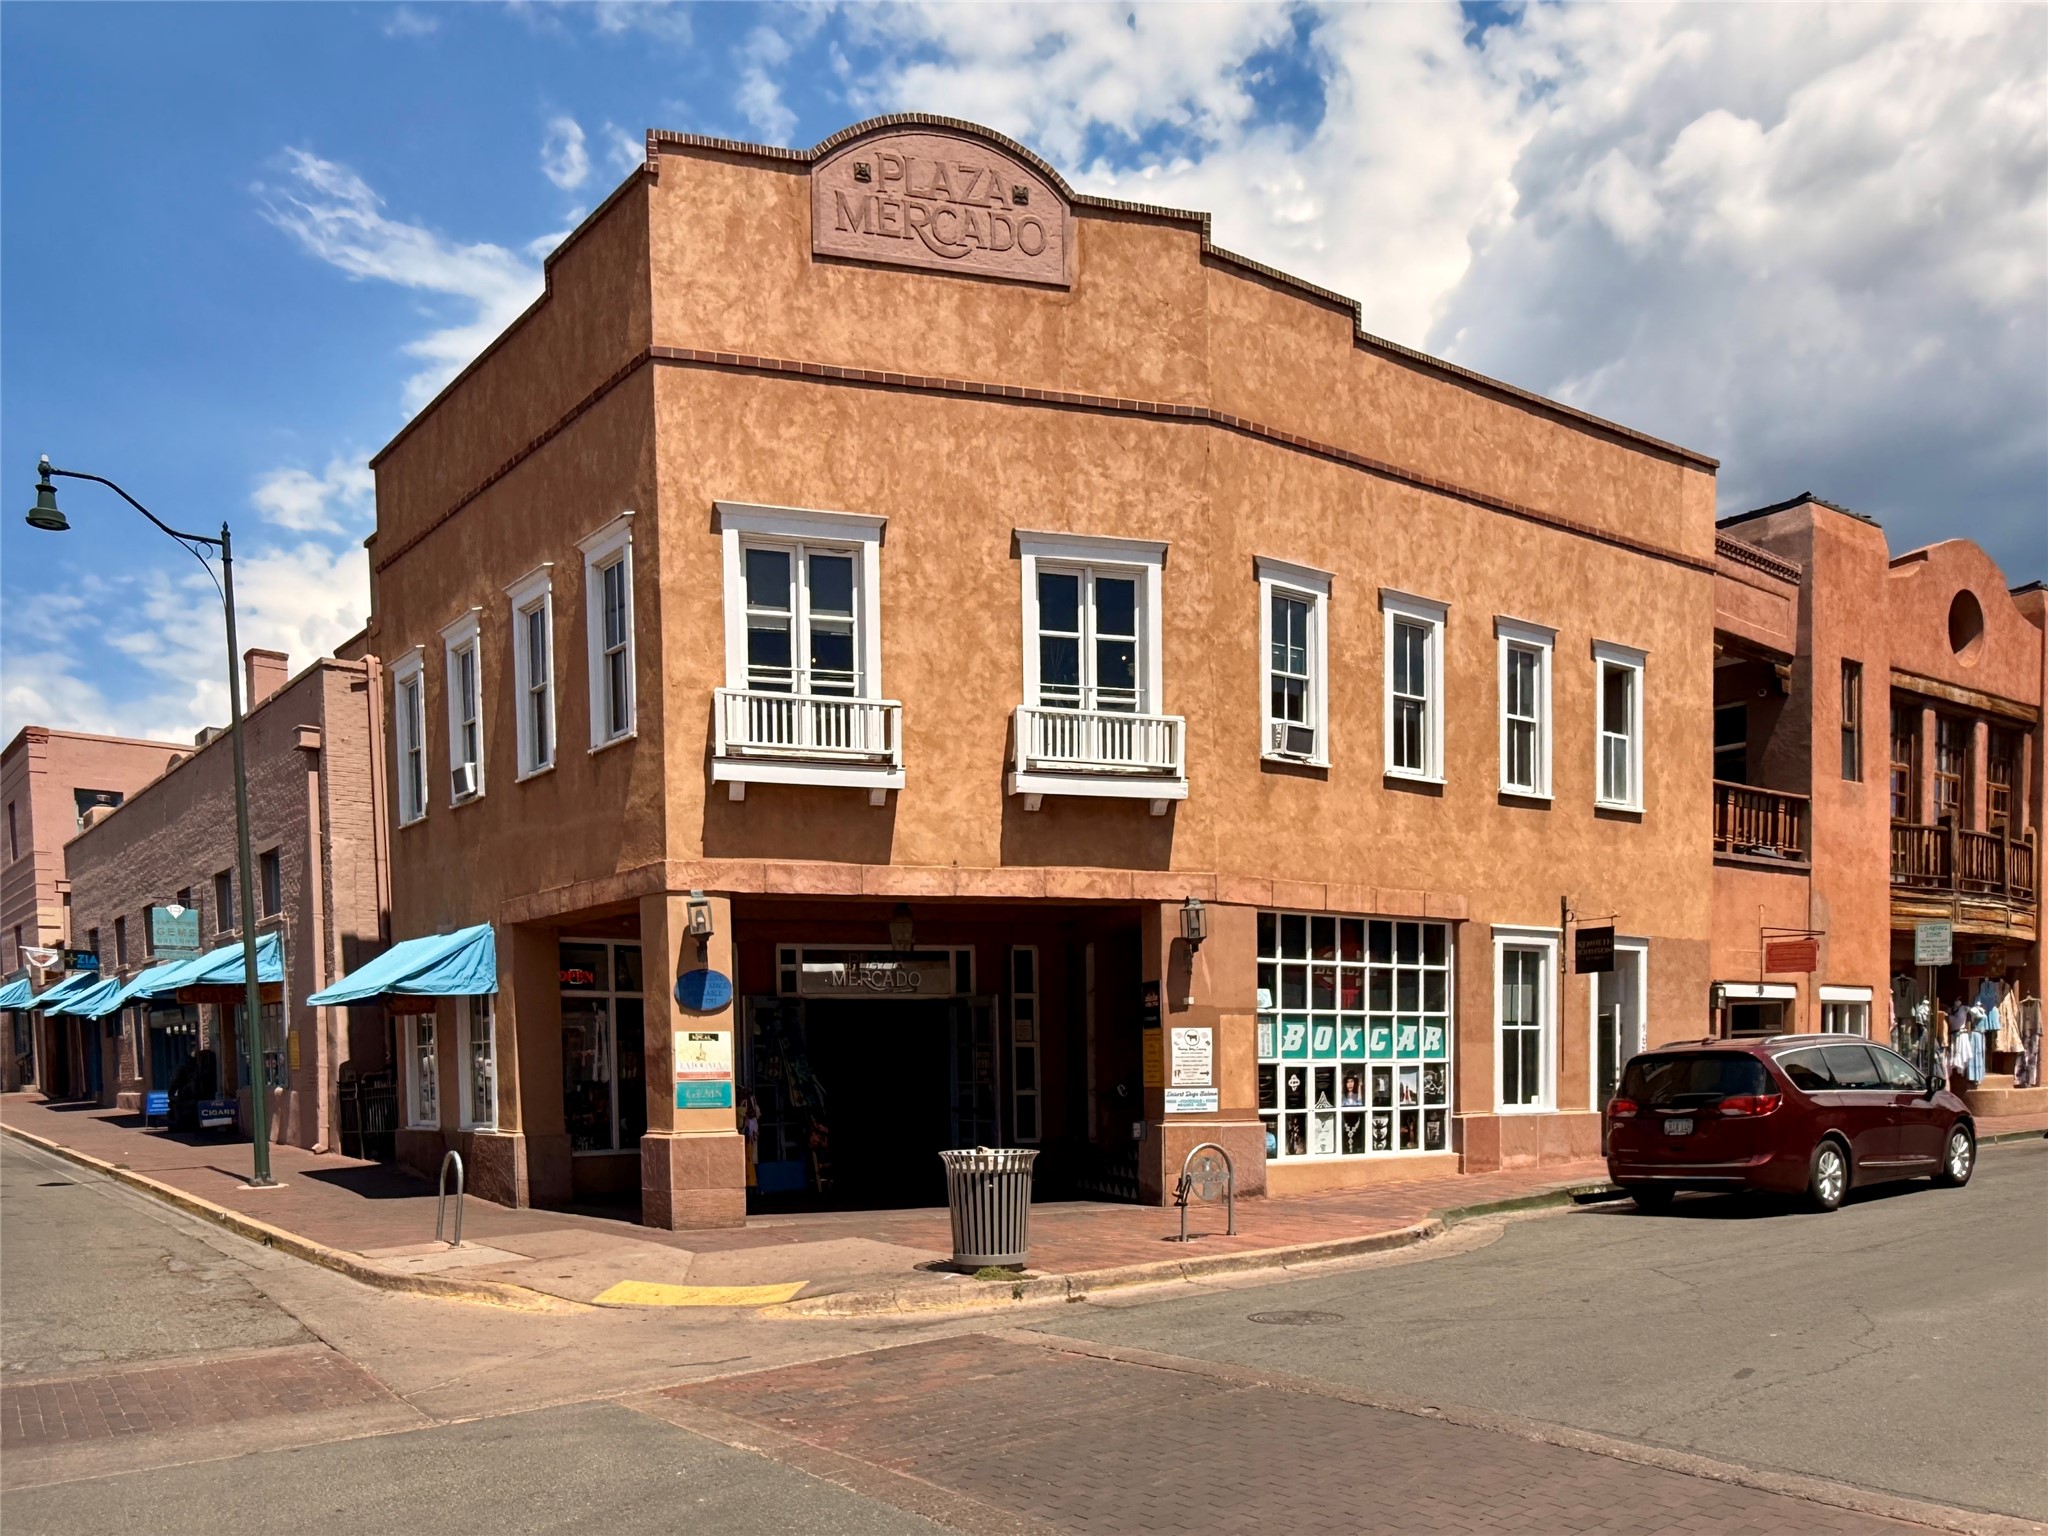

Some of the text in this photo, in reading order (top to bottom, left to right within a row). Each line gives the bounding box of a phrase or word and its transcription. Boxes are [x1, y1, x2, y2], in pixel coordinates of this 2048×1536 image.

[874, 151, 1012, 210] PLAZA
[834, 190, 1046, 258] MERCADO
[156, 928, 196, 937] GEMS
[77, 954, 98, 964] ZIA
[560, 970, 593, 983] OPEN
[831, 969, 921, 990] MERCADO
[1283, 1024, 1442, 1051] BOXCAR
[201, 1109, 236, 1117] CIGARS
